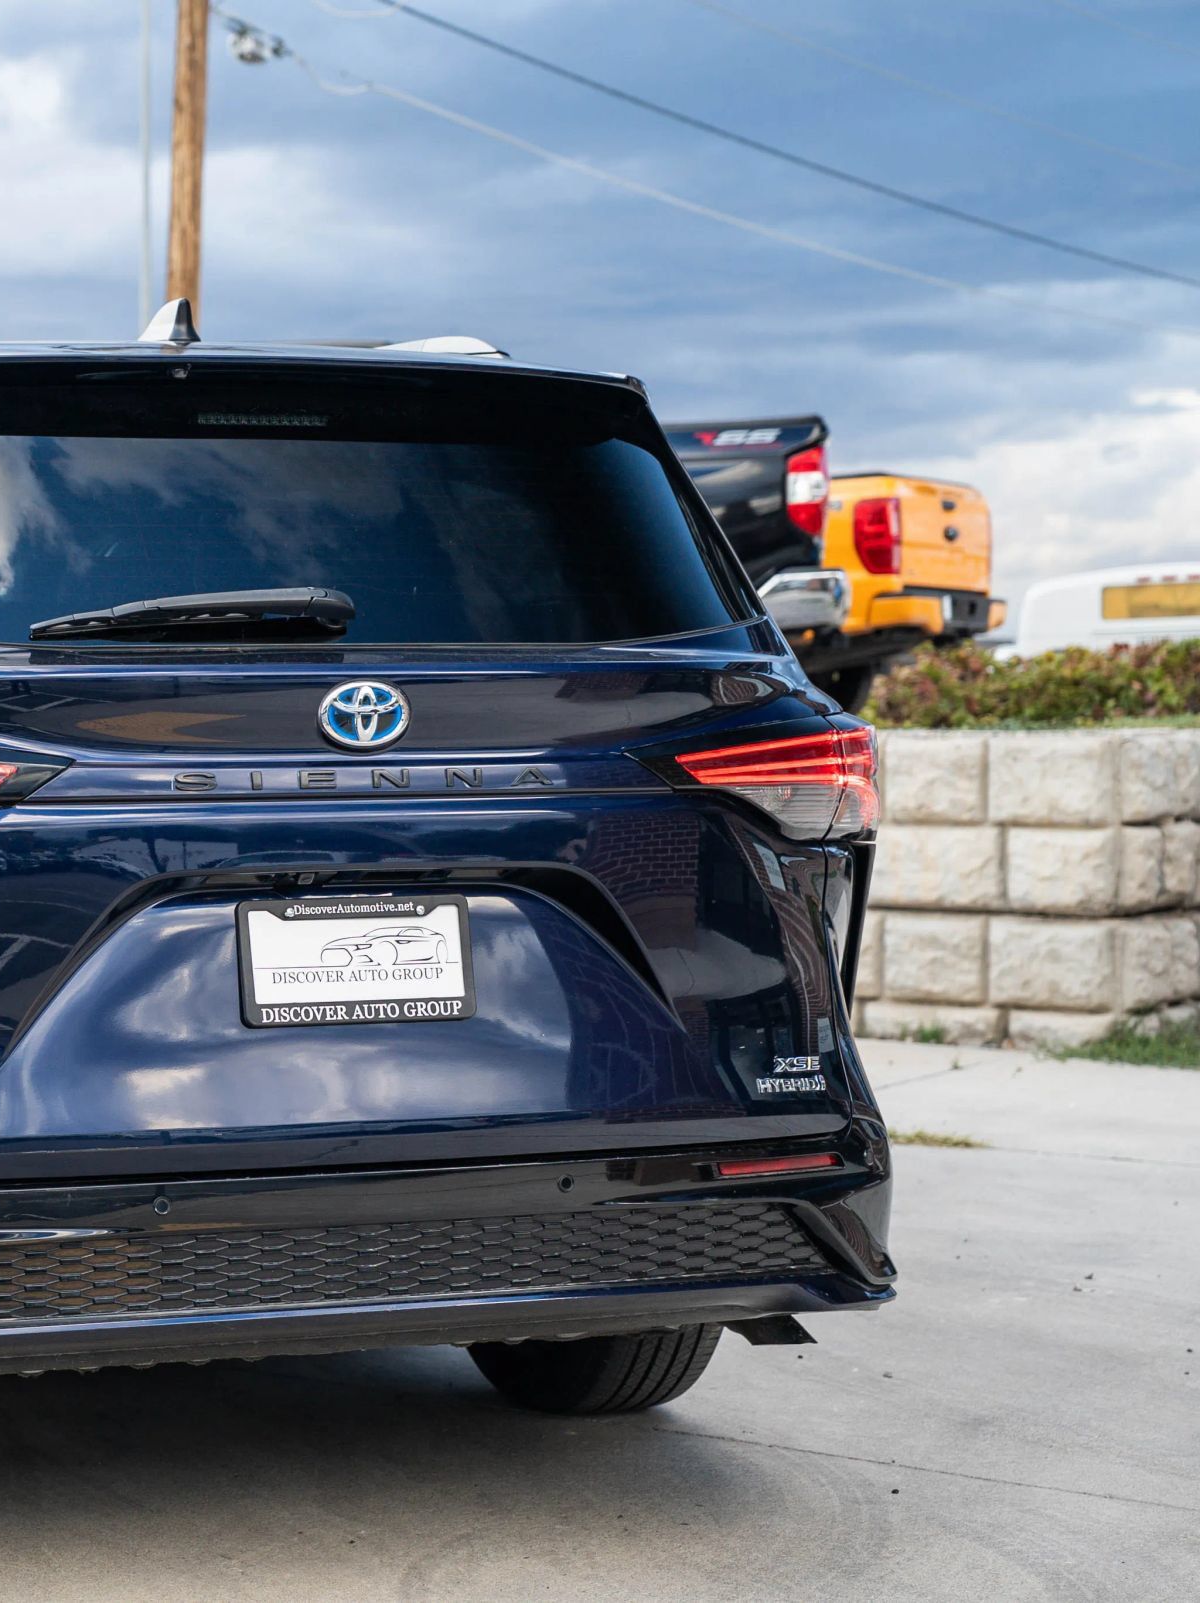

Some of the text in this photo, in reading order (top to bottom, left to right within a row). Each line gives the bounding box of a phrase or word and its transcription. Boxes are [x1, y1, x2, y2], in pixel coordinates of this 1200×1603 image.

[173, 767, 553, 791] SIENNA
[294, 902, 414, 914] DiscoverAutomotive.net
[272, 967, 443, 984] DISCOVER AUTO GROUP
[261, 1001, 462, 1023] DISCOVER AUTO GROUP
[774, 1056, 820, 1073] XSE
[756, 1076, 826, 1093] HYBRID
